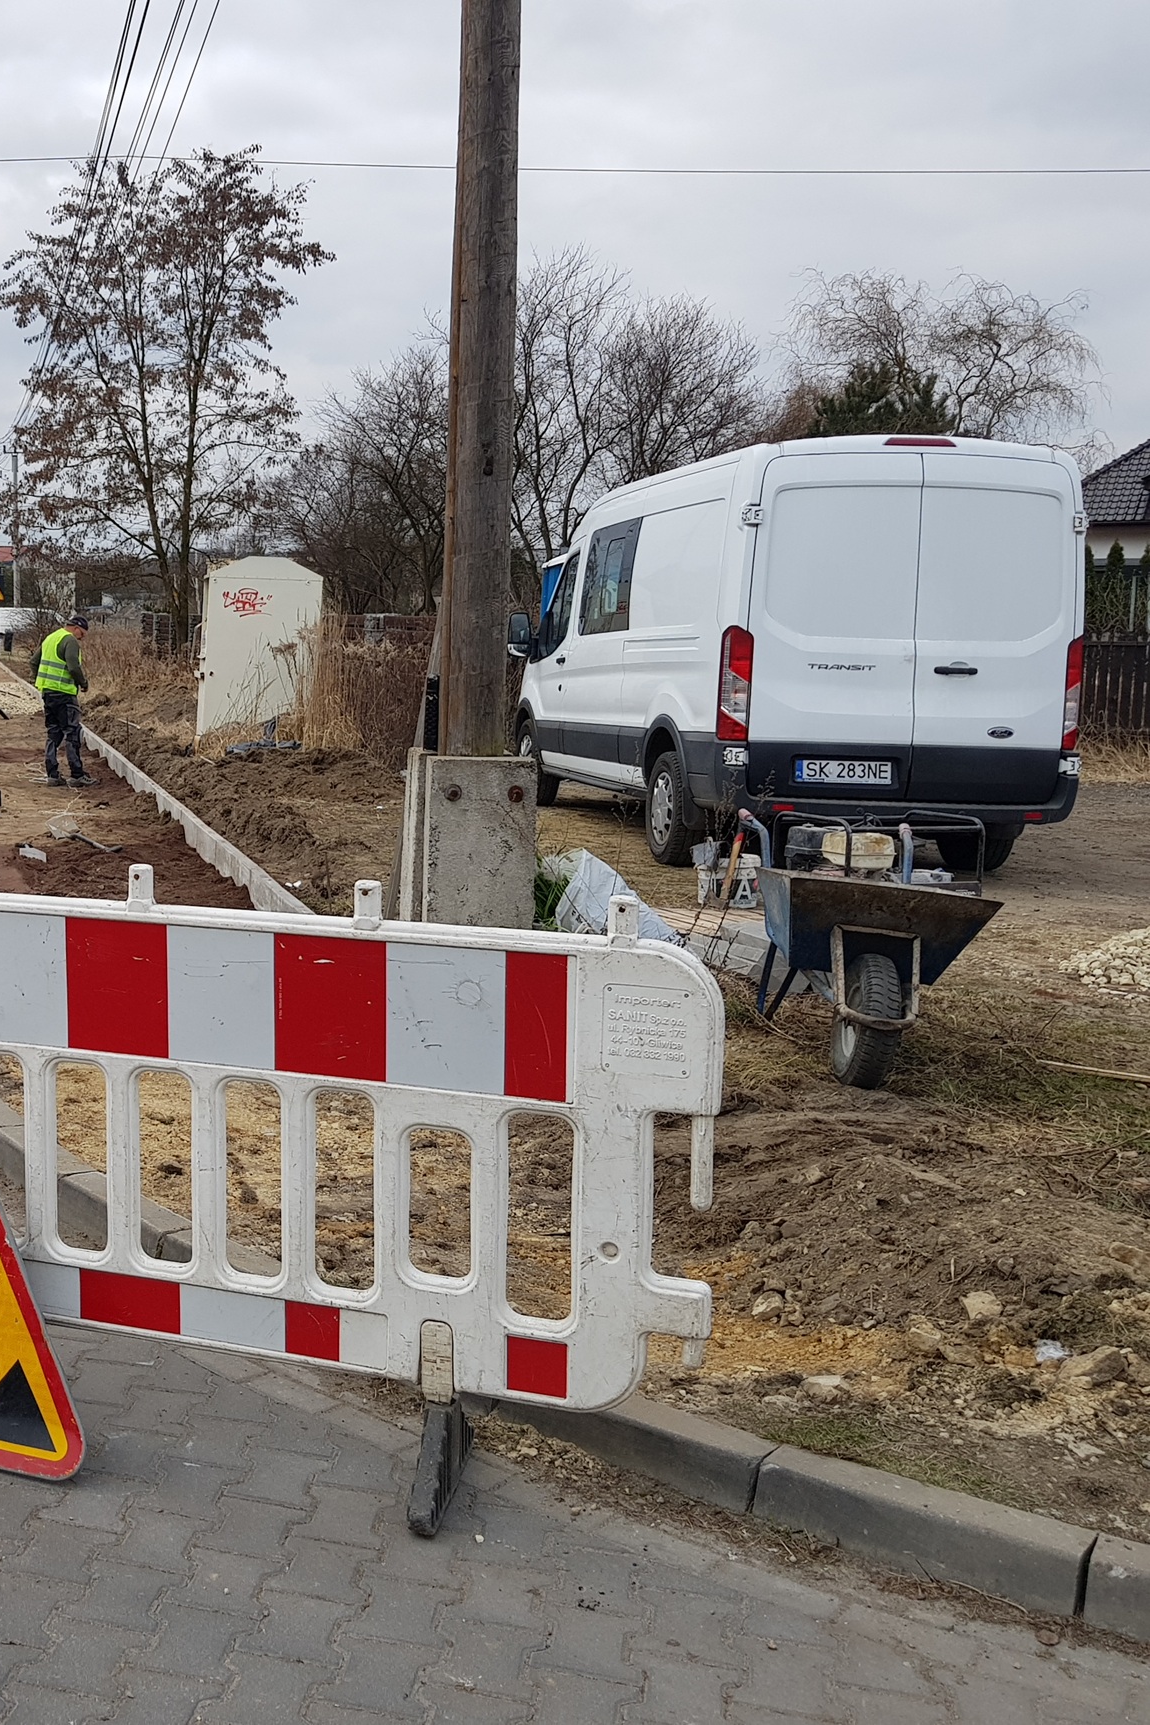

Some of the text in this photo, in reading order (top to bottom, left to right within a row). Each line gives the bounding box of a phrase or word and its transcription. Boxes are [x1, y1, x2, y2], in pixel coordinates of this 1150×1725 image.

[807, 663, 876, 671] TRANSIT
[806, 762, 889, 779] SK 283NE
[608, 1009, 648, 1023] SANIT
[608, 1023, 687, 1039] ul. Rybnicka 175
[647, 1037, 684, 1051] Gliwice
